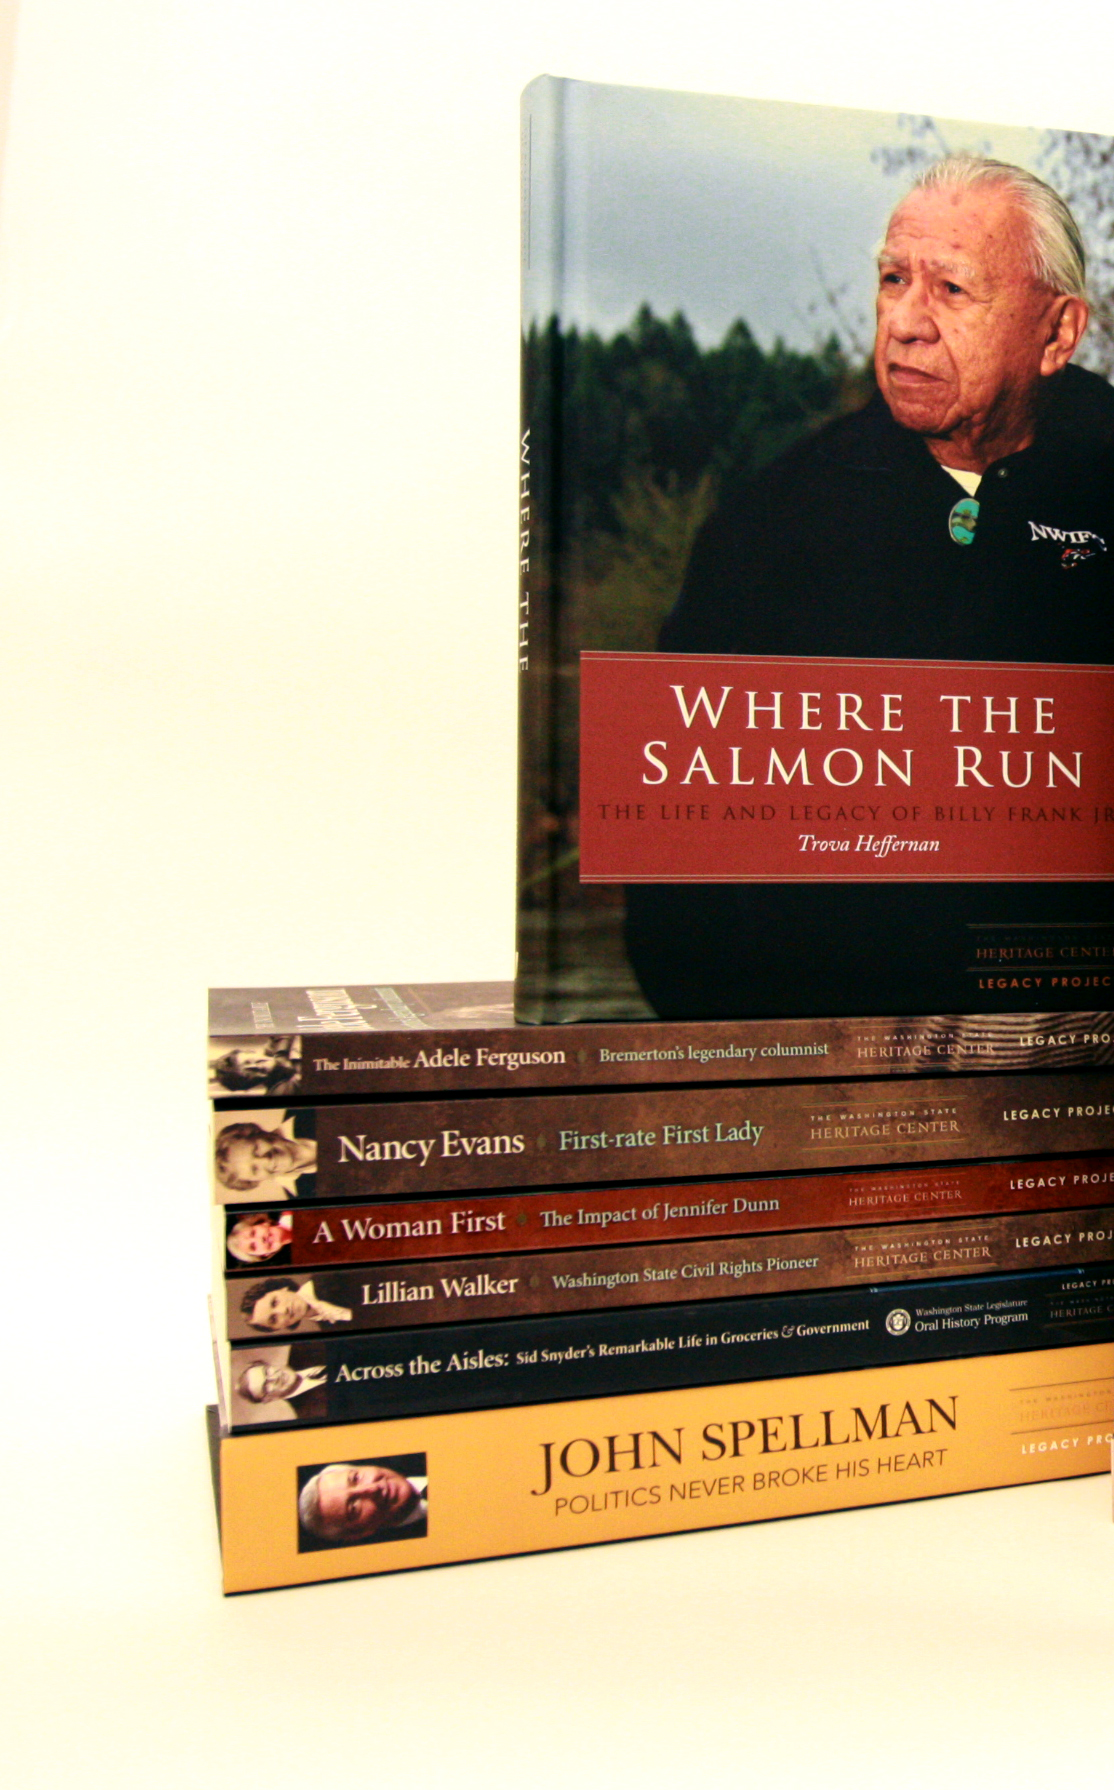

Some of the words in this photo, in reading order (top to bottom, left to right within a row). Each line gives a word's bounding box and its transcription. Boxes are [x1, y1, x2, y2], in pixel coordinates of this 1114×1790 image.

[670, 684, 905, 732] WHERE
[940, 694, 1057, 734] THE
[642, 740, 915, 788] SALMON
[954, 744, 1084, 788] RUN
[598, 803, 646, 821] THE
[660, 803, 711, 821] LIFE
[723, 803, 776, 821] AND
[789, 804, 881, 822] LEGACY
[892, 804, 922, 822] OF
[934, 805, 997, 822] BILLY
[1008, 806, 1083, 823] FRANK
[798, 833, 850, 853] Trova
[854, 833, 940, 858] Heffernan
[976, 947, 1054, 960] HERITAGE
[978, 977, 1042, 989] LEGACY
[1019, 1034, 1076, 1047] LEGACY
[313, 1058, 340, 1072] The
[343, 1055, 411, 1070] Inimitable
[413, 1048, 471, 1069] Adele
[475, 1048, 567, 1071] Ferguson
[599, 1045, 684, 1063] Bremerton's
[687, 1044, 758, 1063] legendary
[760, 1042, 830, 1057] columnist
[857, 1045, 931, 1059] HERITAGE
[937, 1043, 996, 1055] CENTER
[839, 1110, 916, 1120] WASHINGTON
[924, 1107, 957, 1116] STATE
[1003, 1108, 1061, 1121] LEGACY
[810, 1123, 892, 1140] HERITAGE
[897, 1120, 960, 1136] CENTER
[337, 1133, 435, 1166] Nancy
[441, 1130, 525, 1157] Evans
[559, 1128, 656, 1151] First-rate
[662, 1123, 710, 1145] First
[714, 1121, 764, 1146] Lady
[1010, 1176, 1067, 1190] LEGACY
[848, 1193, 910, 1207] HERITAGE
[914, 1189, 963, 1202] CENTER
[313, 1220, 335, 1244] A
[341, 1214, 442, 1241] Woman
[450, 1210, 506, 1234] First
[540, 1210, 574, 1228] The
[577, 1208, 637, 1229] Impact
[642, 1203, 661, 1220] of
[662, 1198, 728, 1222] Jennifer
[733, 1196, 779, 1214] Dunn
[881, 1238, 951, 1250] WASHINGTON
[958, 1235, 990, 1243] STATE
[1015, 1234, 1072, 1249] LEGACY
[854, 1251, 928, 1269] HERITAGE
[933, 1246, 992, 1263] CENTER
[362, 1282, 434, 1306] Lillian
[441, 1274, 519, 1299] Walker
[552, 1269, 639, 1291] Washington
[643, 1266, 677, 1284] State
[681, 1261, 715, 1279] Civil
[718, 1257, 762, 1280] Rights
[766, 1255, 819, 1272] Pioneer
[1061, 1281, 1098, 1291] LEGACY
[915, 1305, 963, 1317] Washington
[964, 1303, 985, 1312] State
[986, 1299, 1028, 1311] Legislature
[1049, 1305, 1104, 1319] HERITAGE
[914, 1319, 939, 1333] Oral
[942, 1316, 981, 1329] History
[984, 1312, 1029, 1326] Program
[335, 1354, 404, 1383] Across
[409, 1354, 441, 1376] the
[446, 1350, 509, 1374] Aisles:
[516, 1349, 537, 1365] Sid
[541, 1344, 596, 1365] Snyder's
[598, 1336, 675, 1357] Remarkable
[678, 1332, 703, 1349] Life
[705, 1331, 718, 1346] in
[721, 1326, 779, 1344] Groceries
[781, 1323, 796, 1339] &
[796, 1318, 870, 1338] Government
[531, 1427, 685, 1497] JOHN
[700, 1396, 959, 1463] SPELLMAN
[1021, 1437, 1080, 1455] LEGACY
[554, 1485, 662, 1517] POLITICS
[668, 1475, 745, 1502] NEVER
[752, 1464, 828, 1491] BROKE
[835, 1457, 870, 1479] HIS
[876, 1448, 948, 1474] HEART
